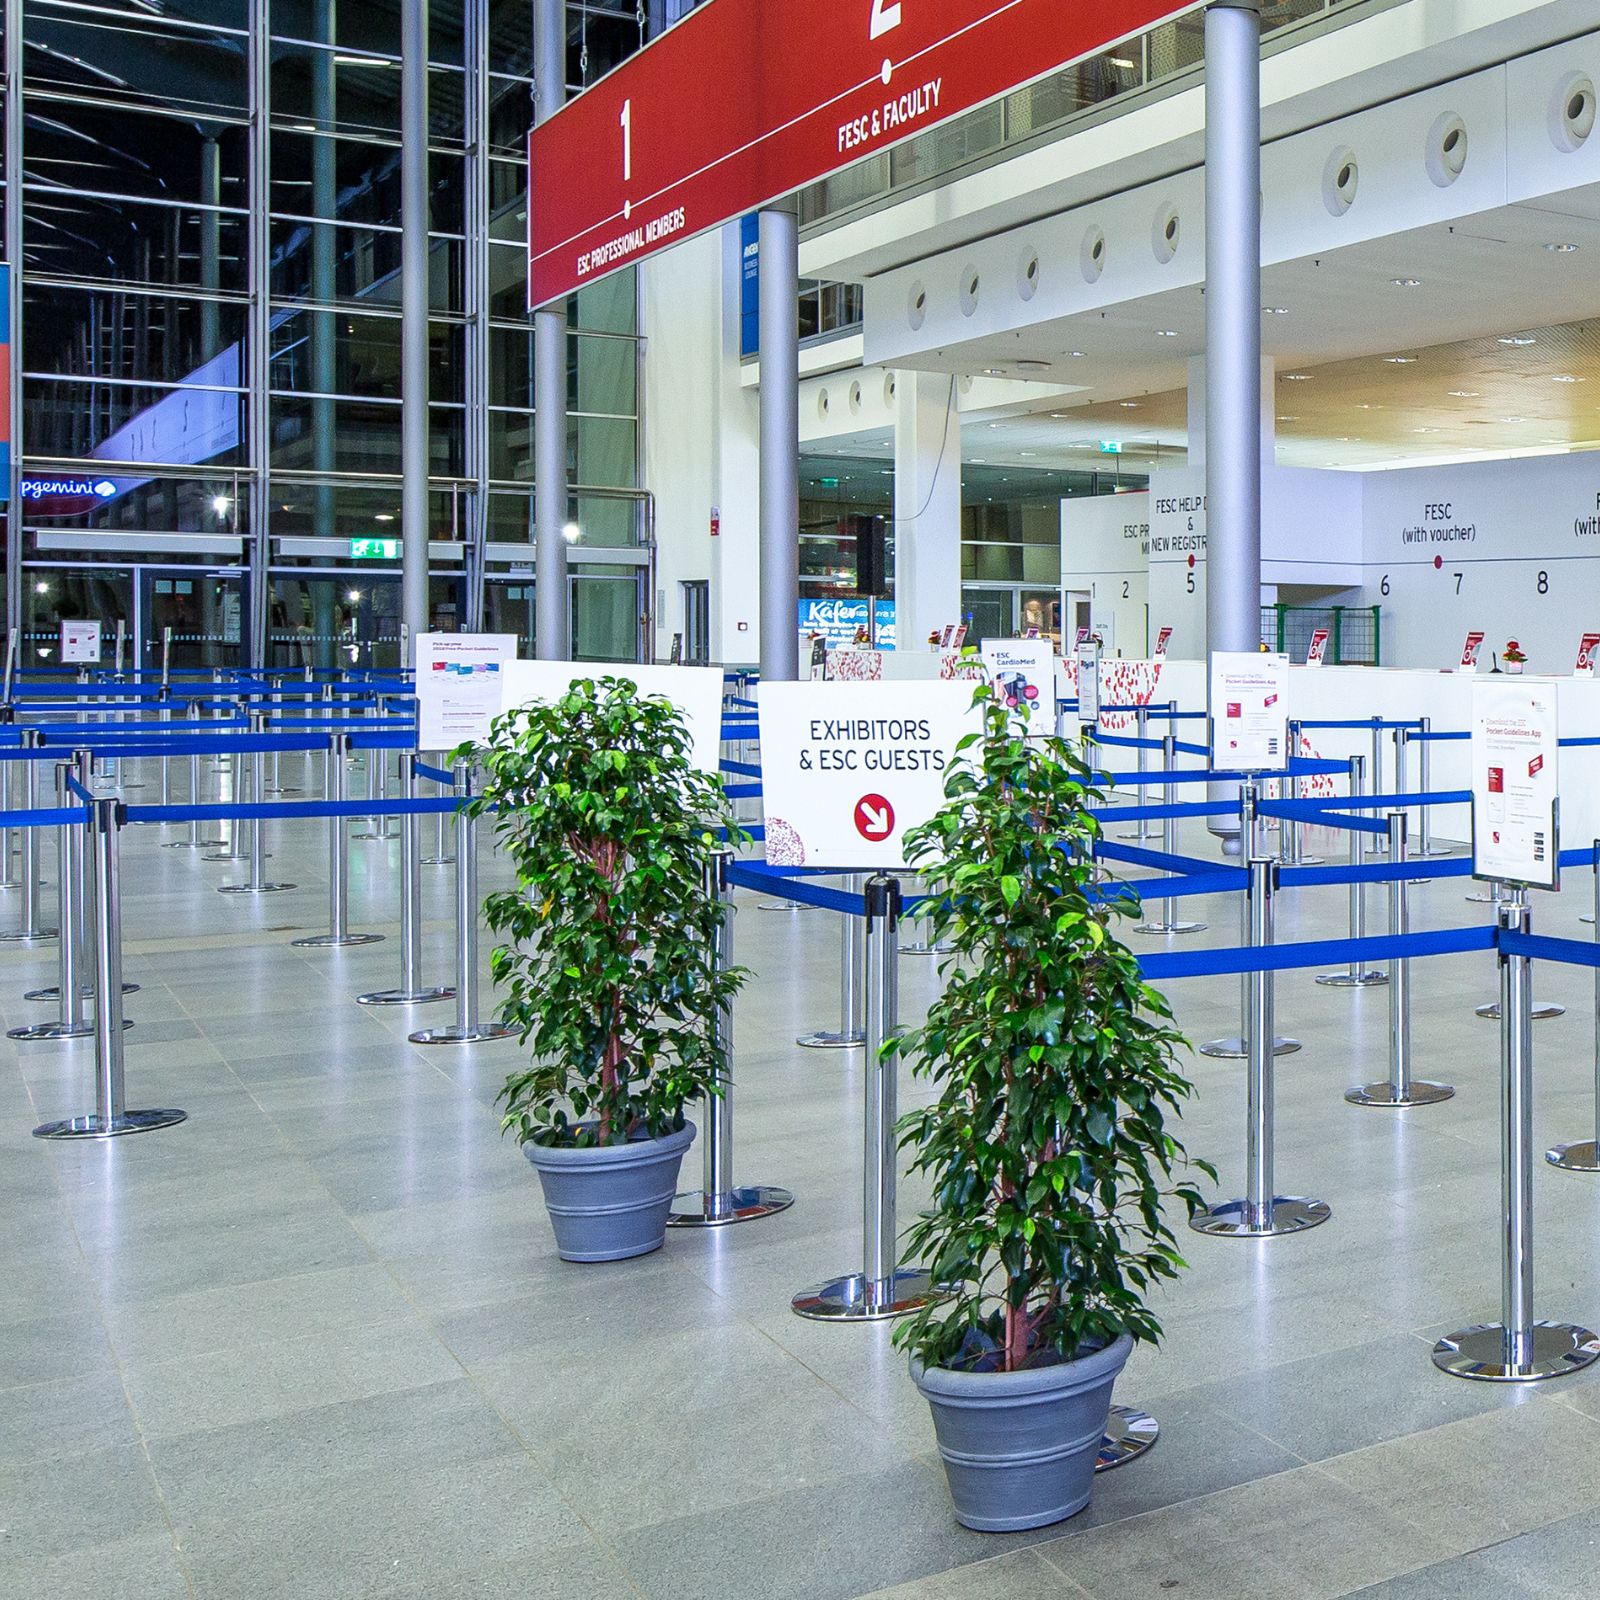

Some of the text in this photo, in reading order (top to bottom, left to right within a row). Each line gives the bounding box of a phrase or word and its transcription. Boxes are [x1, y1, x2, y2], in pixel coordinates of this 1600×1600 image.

[838, 77, 942, 153] FESC & FACULTY
[620, 99, 631, 181] 1
[577, 206, 686, 276] ESC PROFESSIONAL MEMBERS
[1156, 498, 1177, 514] FESC
[1179, 496, 1201, 513] HELP
[1424, 503, 1452, 521] FESC
[1124, 525, 1138, 538] ESC
[1187, 516, 1194, 531] &
[1402, 523, 1476, 544] (with voucher)
[1152, 537, 1170, 551] NEW
[1092, 582, 1096, 599] 1
[1122, 581, 1129, 599] 2
[1186, 572, 1196, 594] 5
[1381, 574, 1390, 596] 6
[1453, 572, 1463, 595] 7
[1537, 570, 1549, 594] 8
[808, 600, 868, 625] Käfer
[996, 658, 1036, 666] CardioMed
[810, 719, 931, 741] EXHIBITORS
[799, 749, 945, 771] & ESC GUESTS
